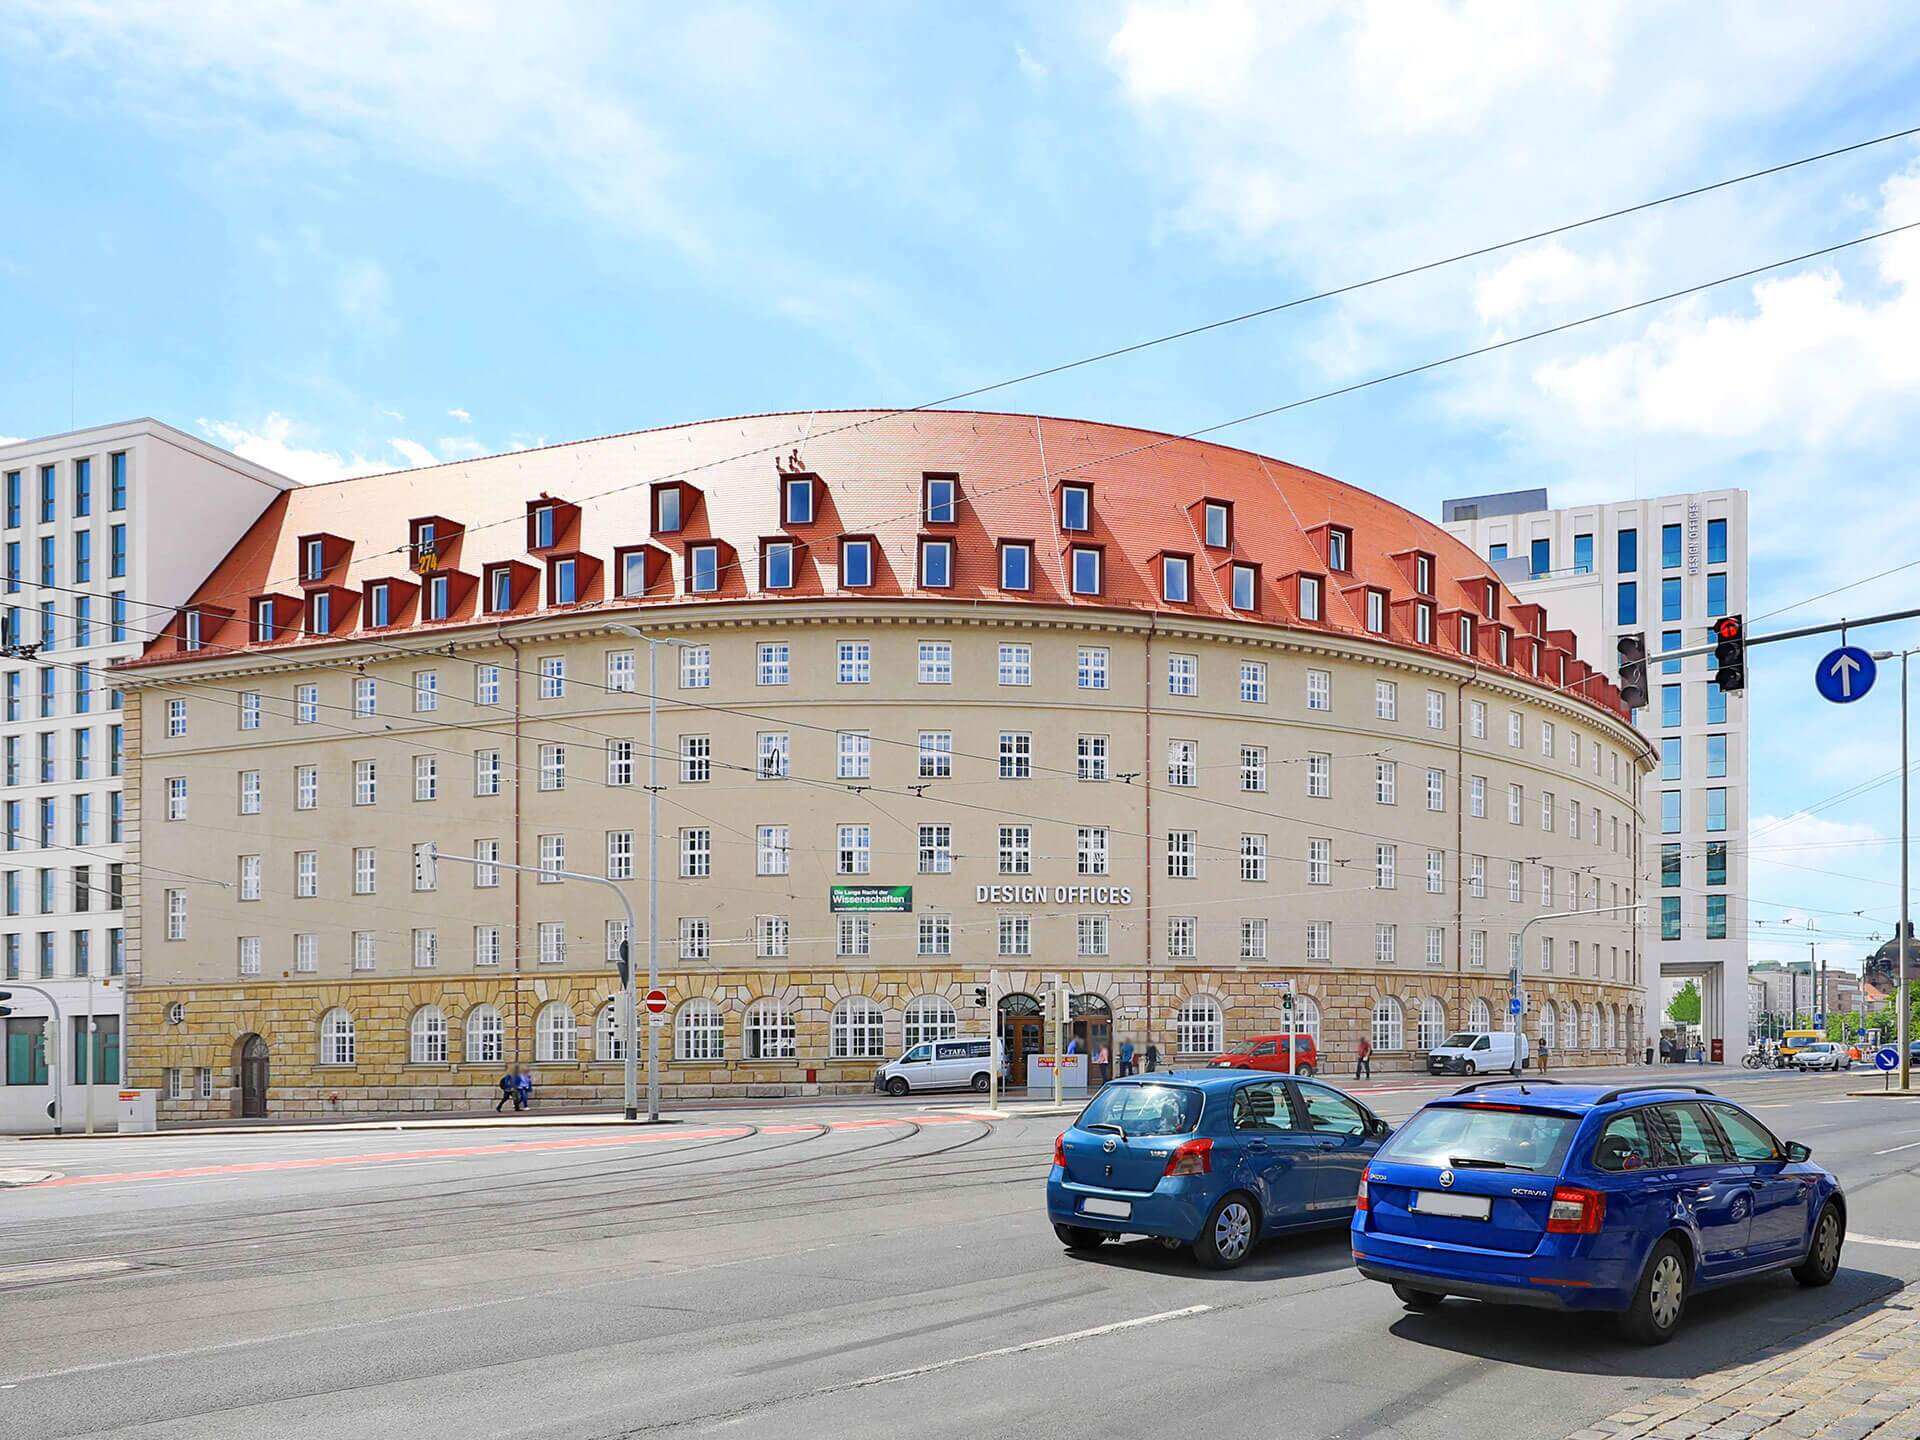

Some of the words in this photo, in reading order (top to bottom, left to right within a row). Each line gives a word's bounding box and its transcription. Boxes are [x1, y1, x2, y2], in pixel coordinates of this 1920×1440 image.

[1688, 501, 1699, 539] OFFICES
[1688, 542, 1699, 576] DESIGN
[832, 895, 904, 903] Wissenschaften
[976, 885, 1048, 904] DESIGN
[1055, 886, 1132, 905] OFFICES
[1511, 1188, 1548, 1197] OCTAVIA
